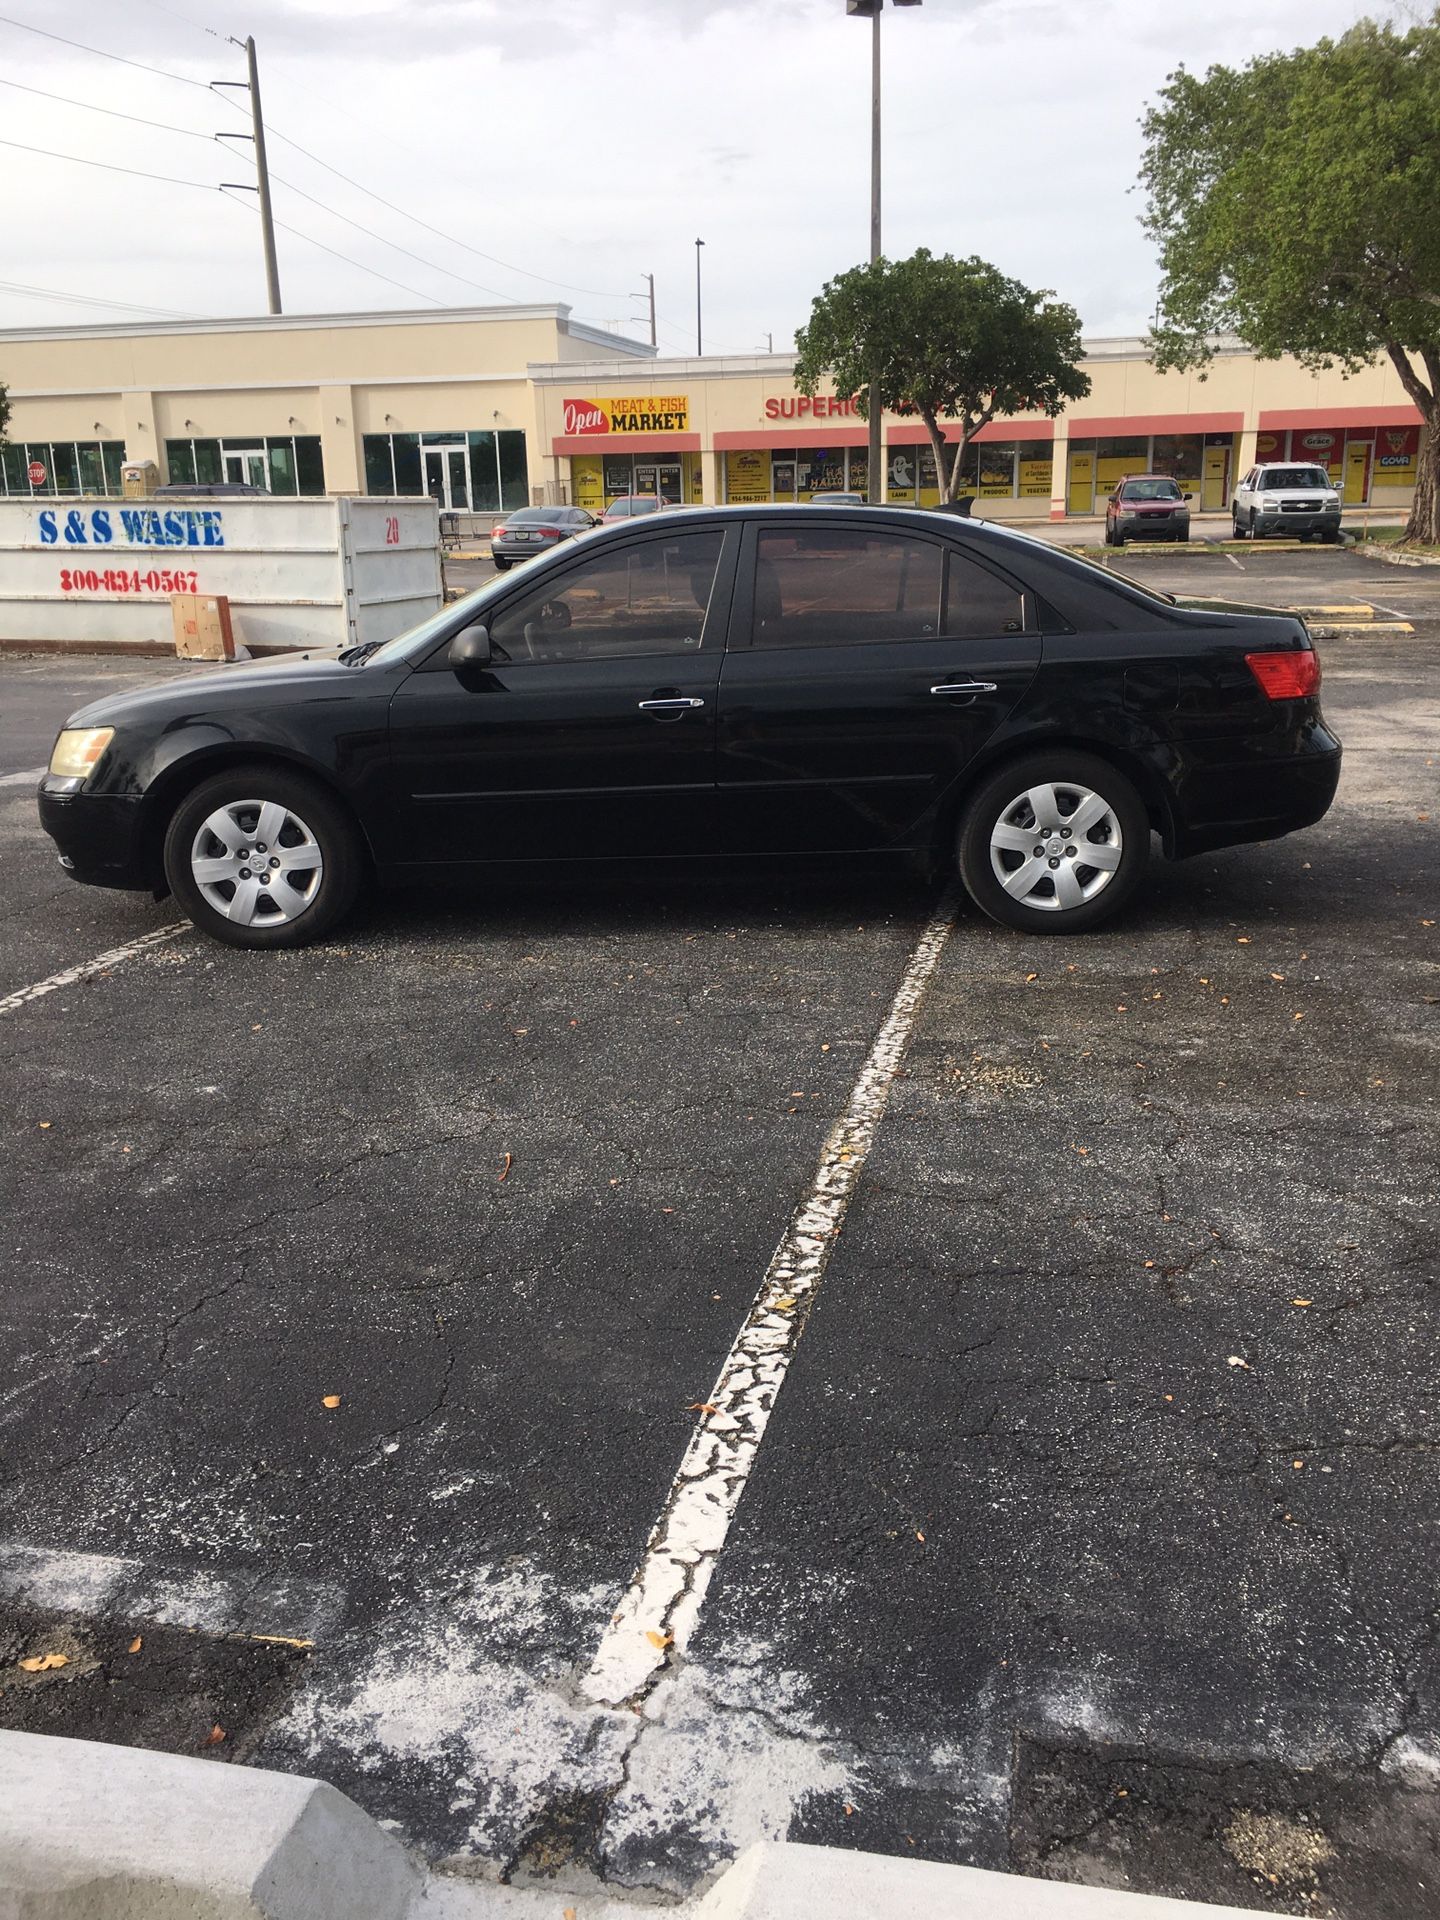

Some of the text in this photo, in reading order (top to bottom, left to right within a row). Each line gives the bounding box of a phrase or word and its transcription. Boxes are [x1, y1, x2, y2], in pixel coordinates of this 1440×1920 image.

[611, 397, 686, 413] MEAT & FISH
[565, 404, 603, 434] Open
[611, 412, 686, 431] MARKET
[1381, 456, 1409, 466] GOYA
[29, 468, 45, 478] STOP
[39, 510, 224, 546] S & S WASTE
[385, 516, 399, 544] 20
[60, 569, 198, 593] 800-834-0567
